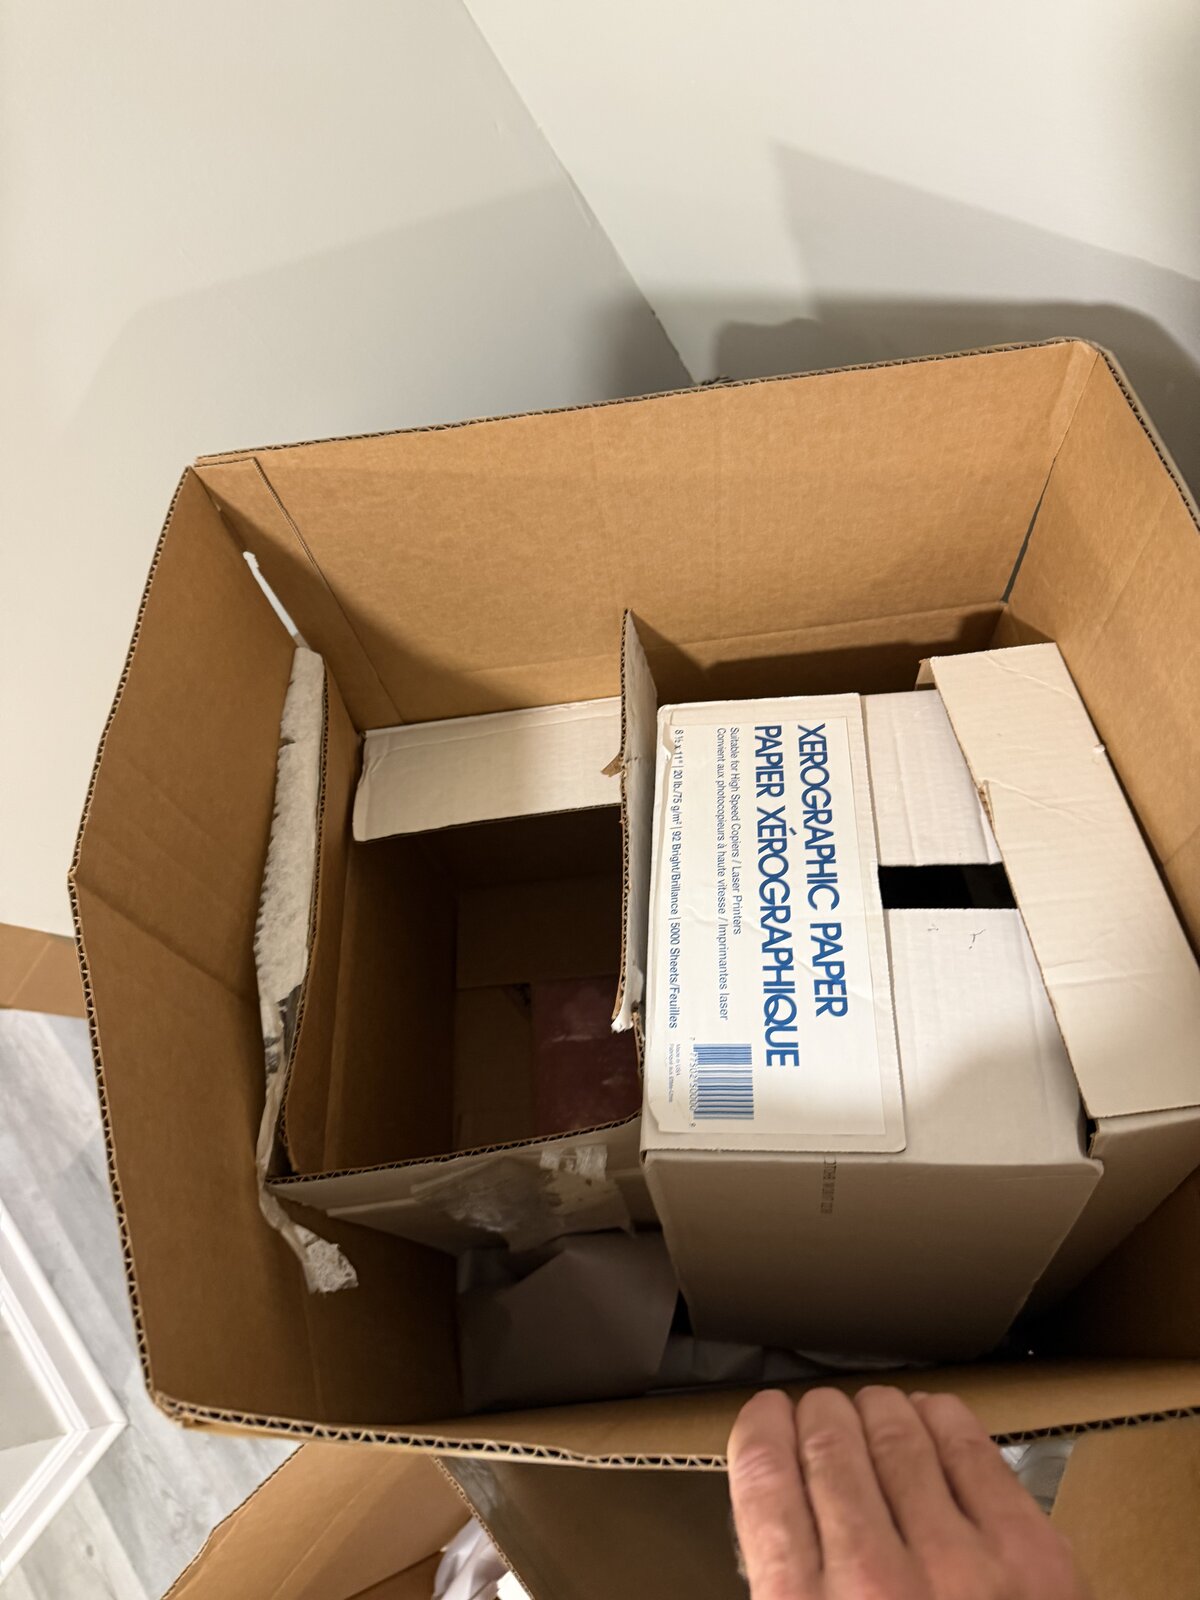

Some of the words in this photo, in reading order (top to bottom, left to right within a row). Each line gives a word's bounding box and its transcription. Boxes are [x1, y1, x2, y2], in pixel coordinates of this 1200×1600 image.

[715, 728, 727, 762] Convient
[730, 727, 740, 759] Suitable
[673, 770, 683, 780] 20
[716, 764, 725, 779] aux
[730, 760, 740, 772] for
[754, 725, 784, 798] PAPIER
[728, 773, 740, 792] High
[715, 780, 727, 841] photocopieurs
[728, 793, 741, 821] Speed
[798, 723, 840, 910] XEROGRAPHIC
[672, 831, 681, 842] 92
[729, 823, 741, 857] Copiers
[669, 843, 681, 915] Bright/Brillance
[717, 851, 727, 877] haute
[732, 866, 742, 893] Laser
[717, 880, 727, 914] vitesse
[733, 895, 744, 935] Printers
[670, 922, 680, 945] 5000
[757, 805, 800, 1066] XÉROGRAPHIQUE
[716, 924, 729, 990] Imprimantes
[810, 923, 848, 1017] PAPER
[669, 948, 680, 1028] Sheets/Feuilles
[720, 993, 730, 1020] laser
